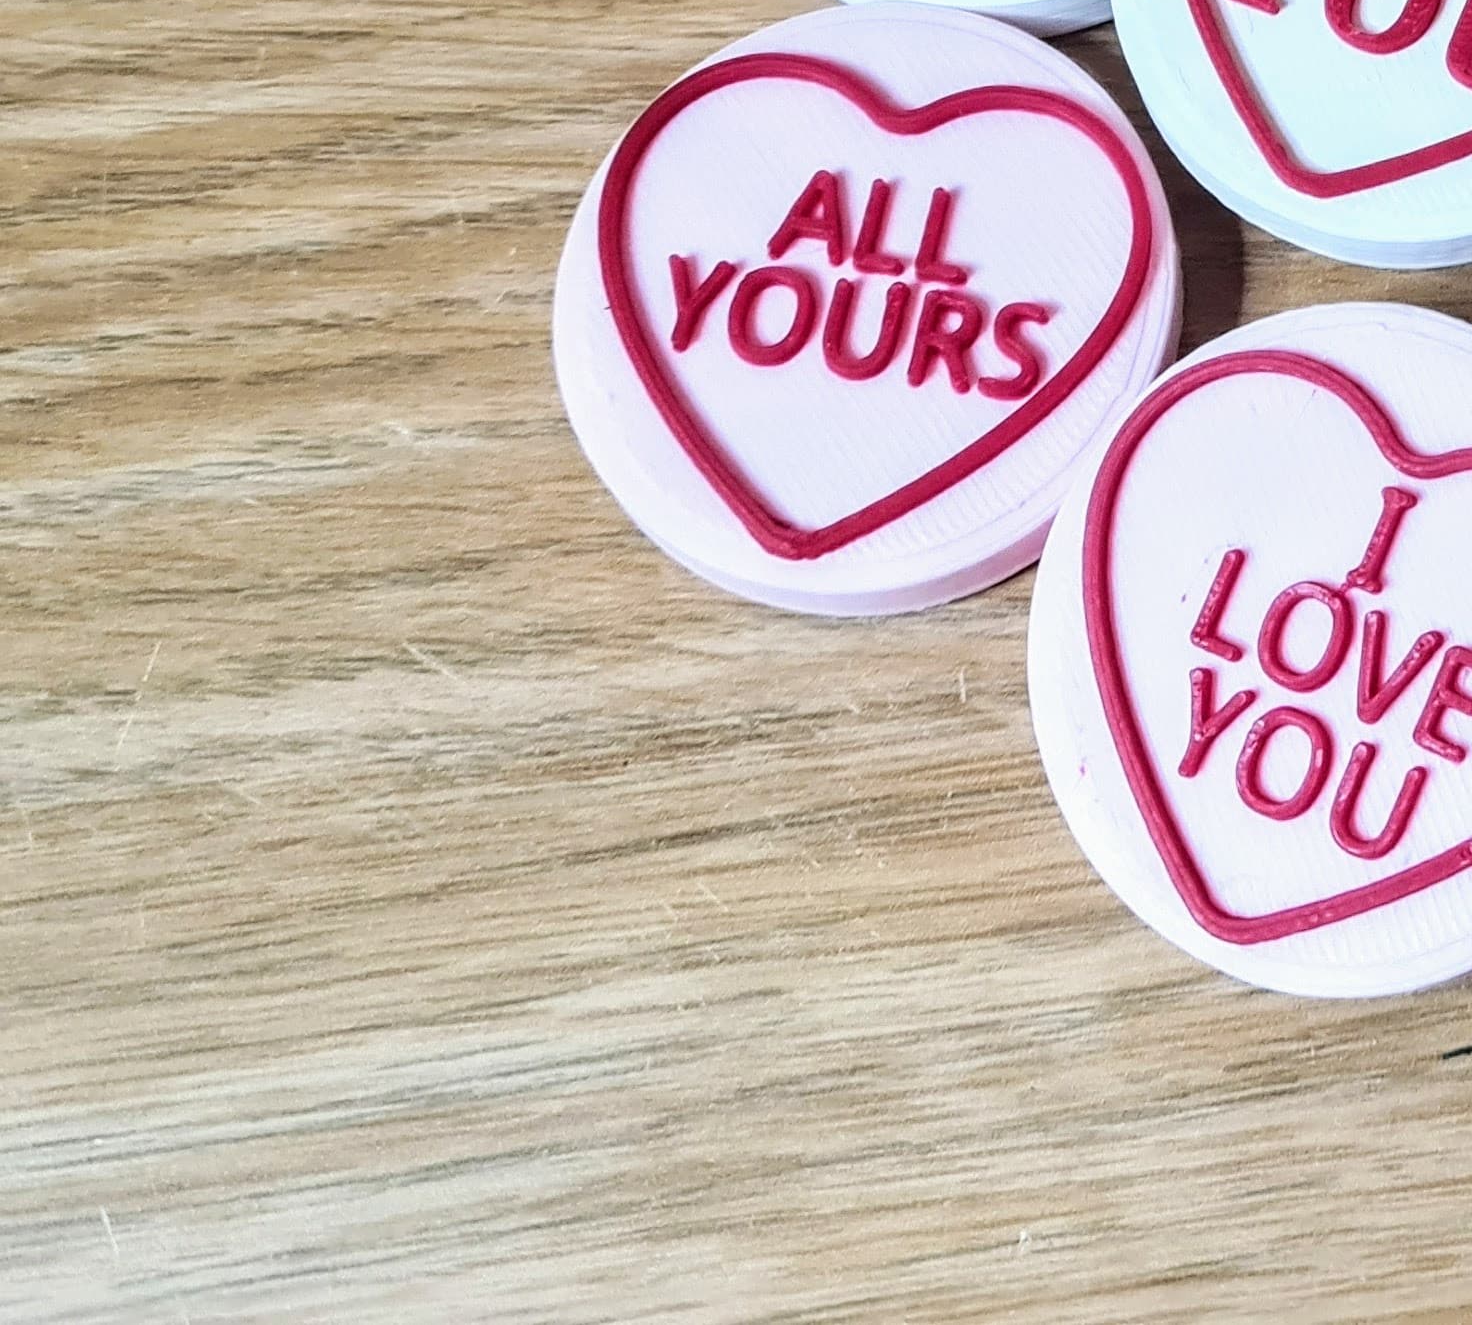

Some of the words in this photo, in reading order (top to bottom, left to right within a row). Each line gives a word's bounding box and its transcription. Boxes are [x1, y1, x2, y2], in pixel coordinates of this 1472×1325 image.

[766, 169, 970, 287] ALL
[668, 254, 1052, 403] YOURS
[1346, 485, 1420, 595] I
[1177, 667, 1430, 862] YOU
